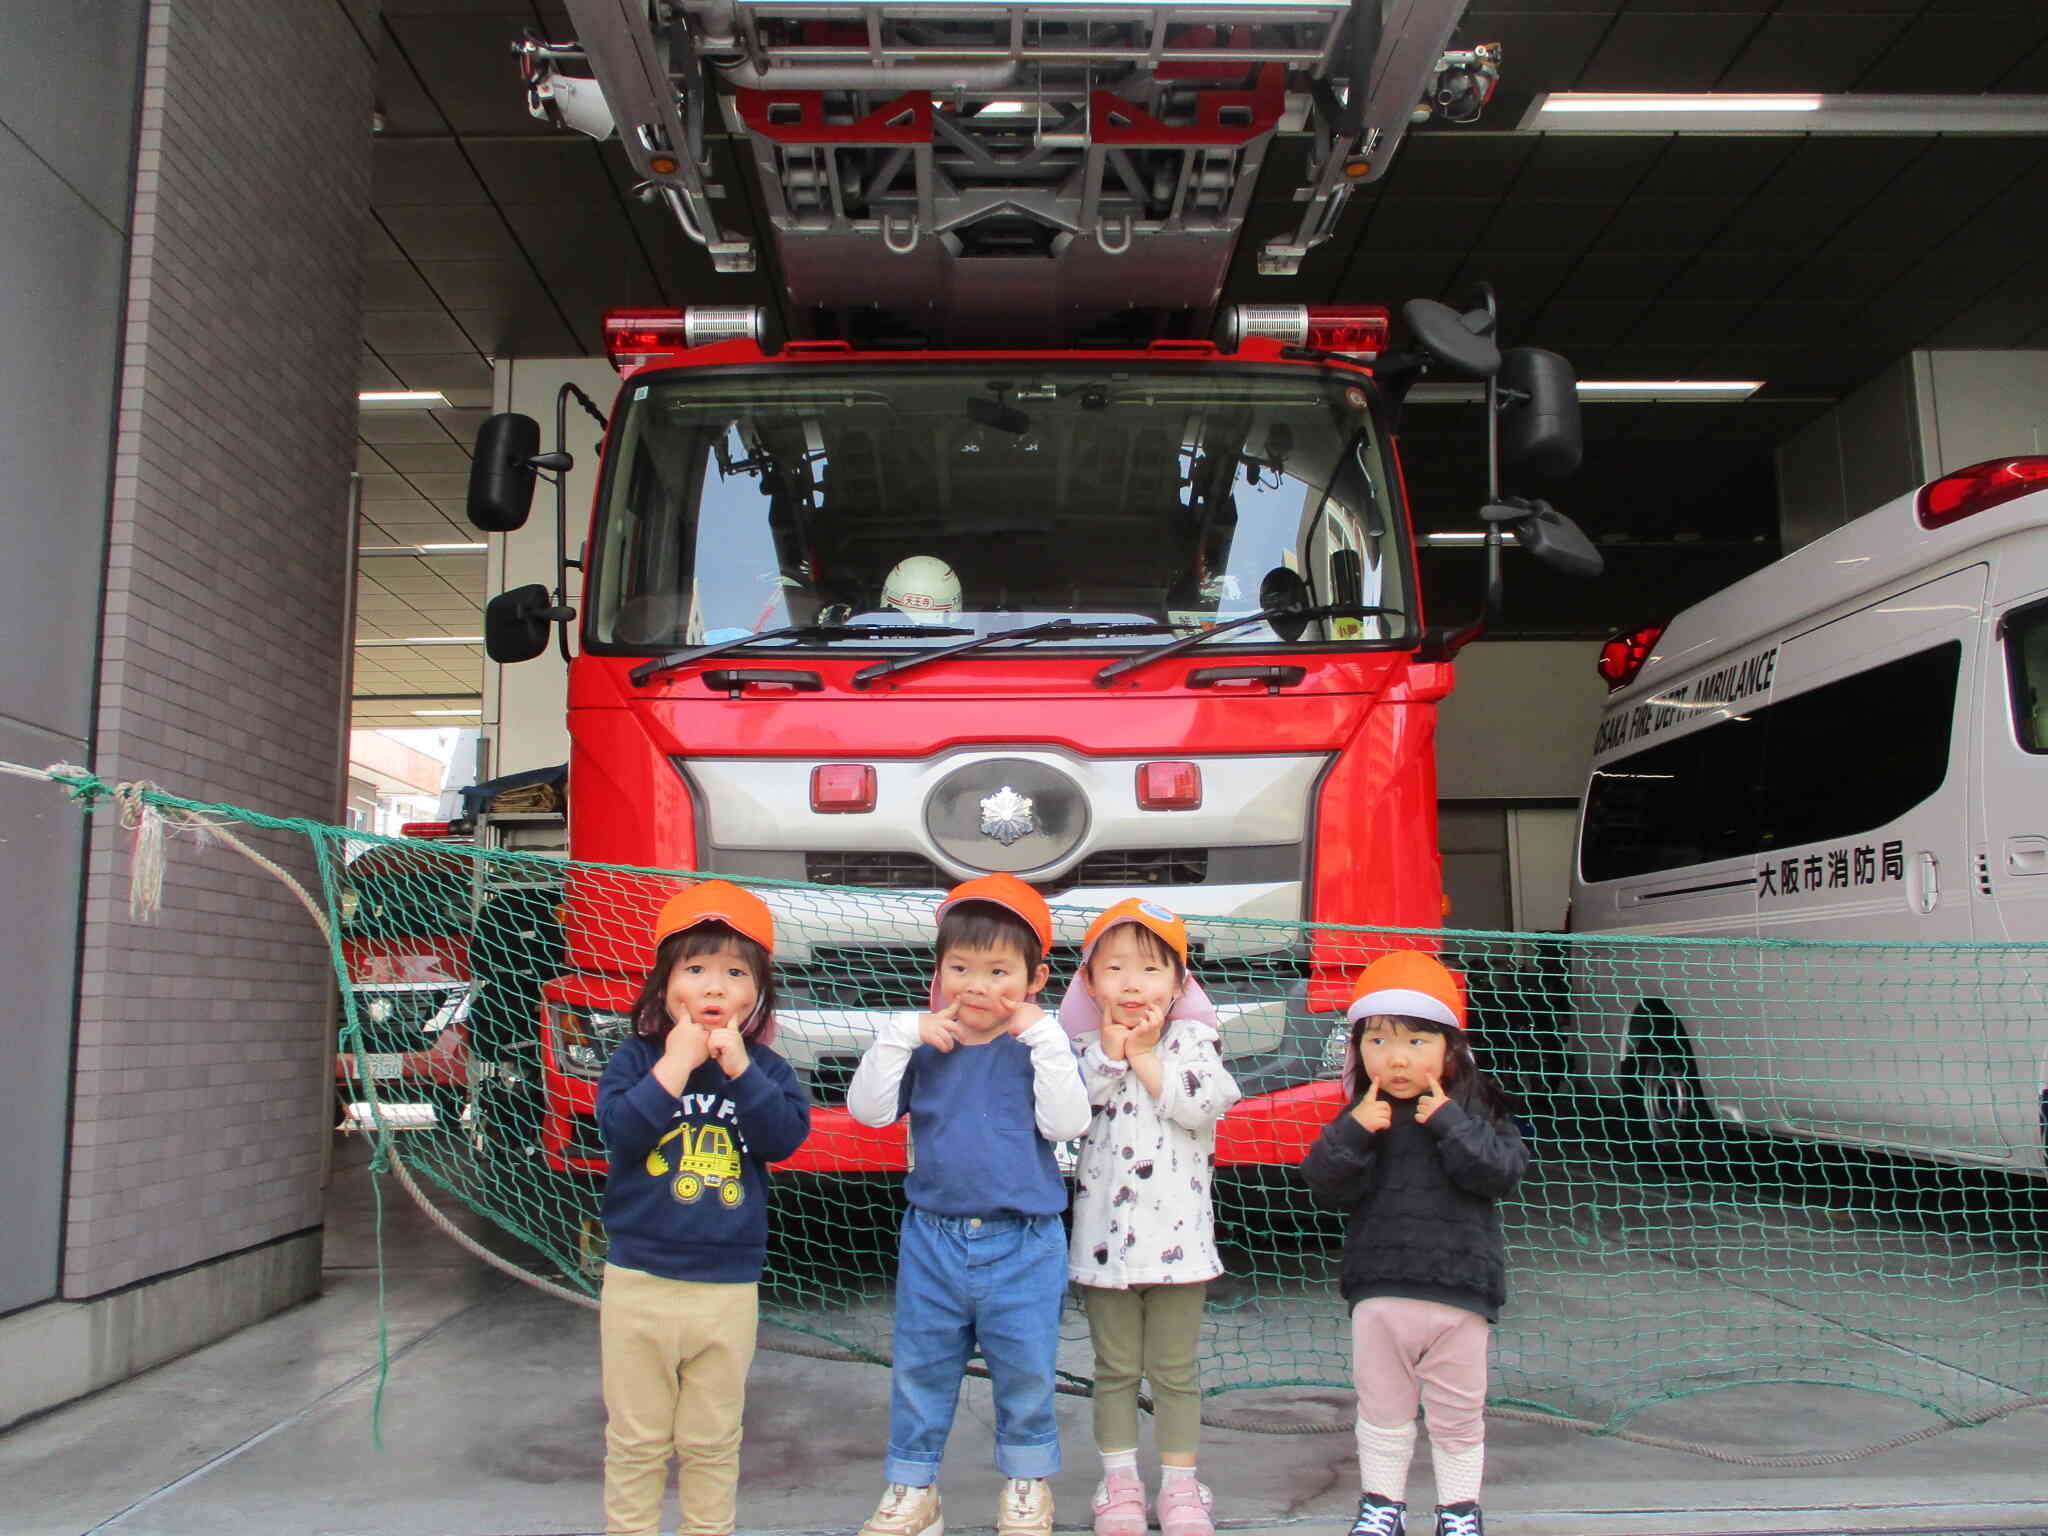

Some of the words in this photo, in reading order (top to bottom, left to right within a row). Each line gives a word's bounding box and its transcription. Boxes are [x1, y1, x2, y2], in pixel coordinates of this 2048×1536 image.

[1593, 712, 1629, 756] OSAKA
[1629, 703, 1653, 742] FIRE
[1689, 648, 1778, 718] AMBULANCE
[1759, 840, 1904, 899] 大阪市消防局
